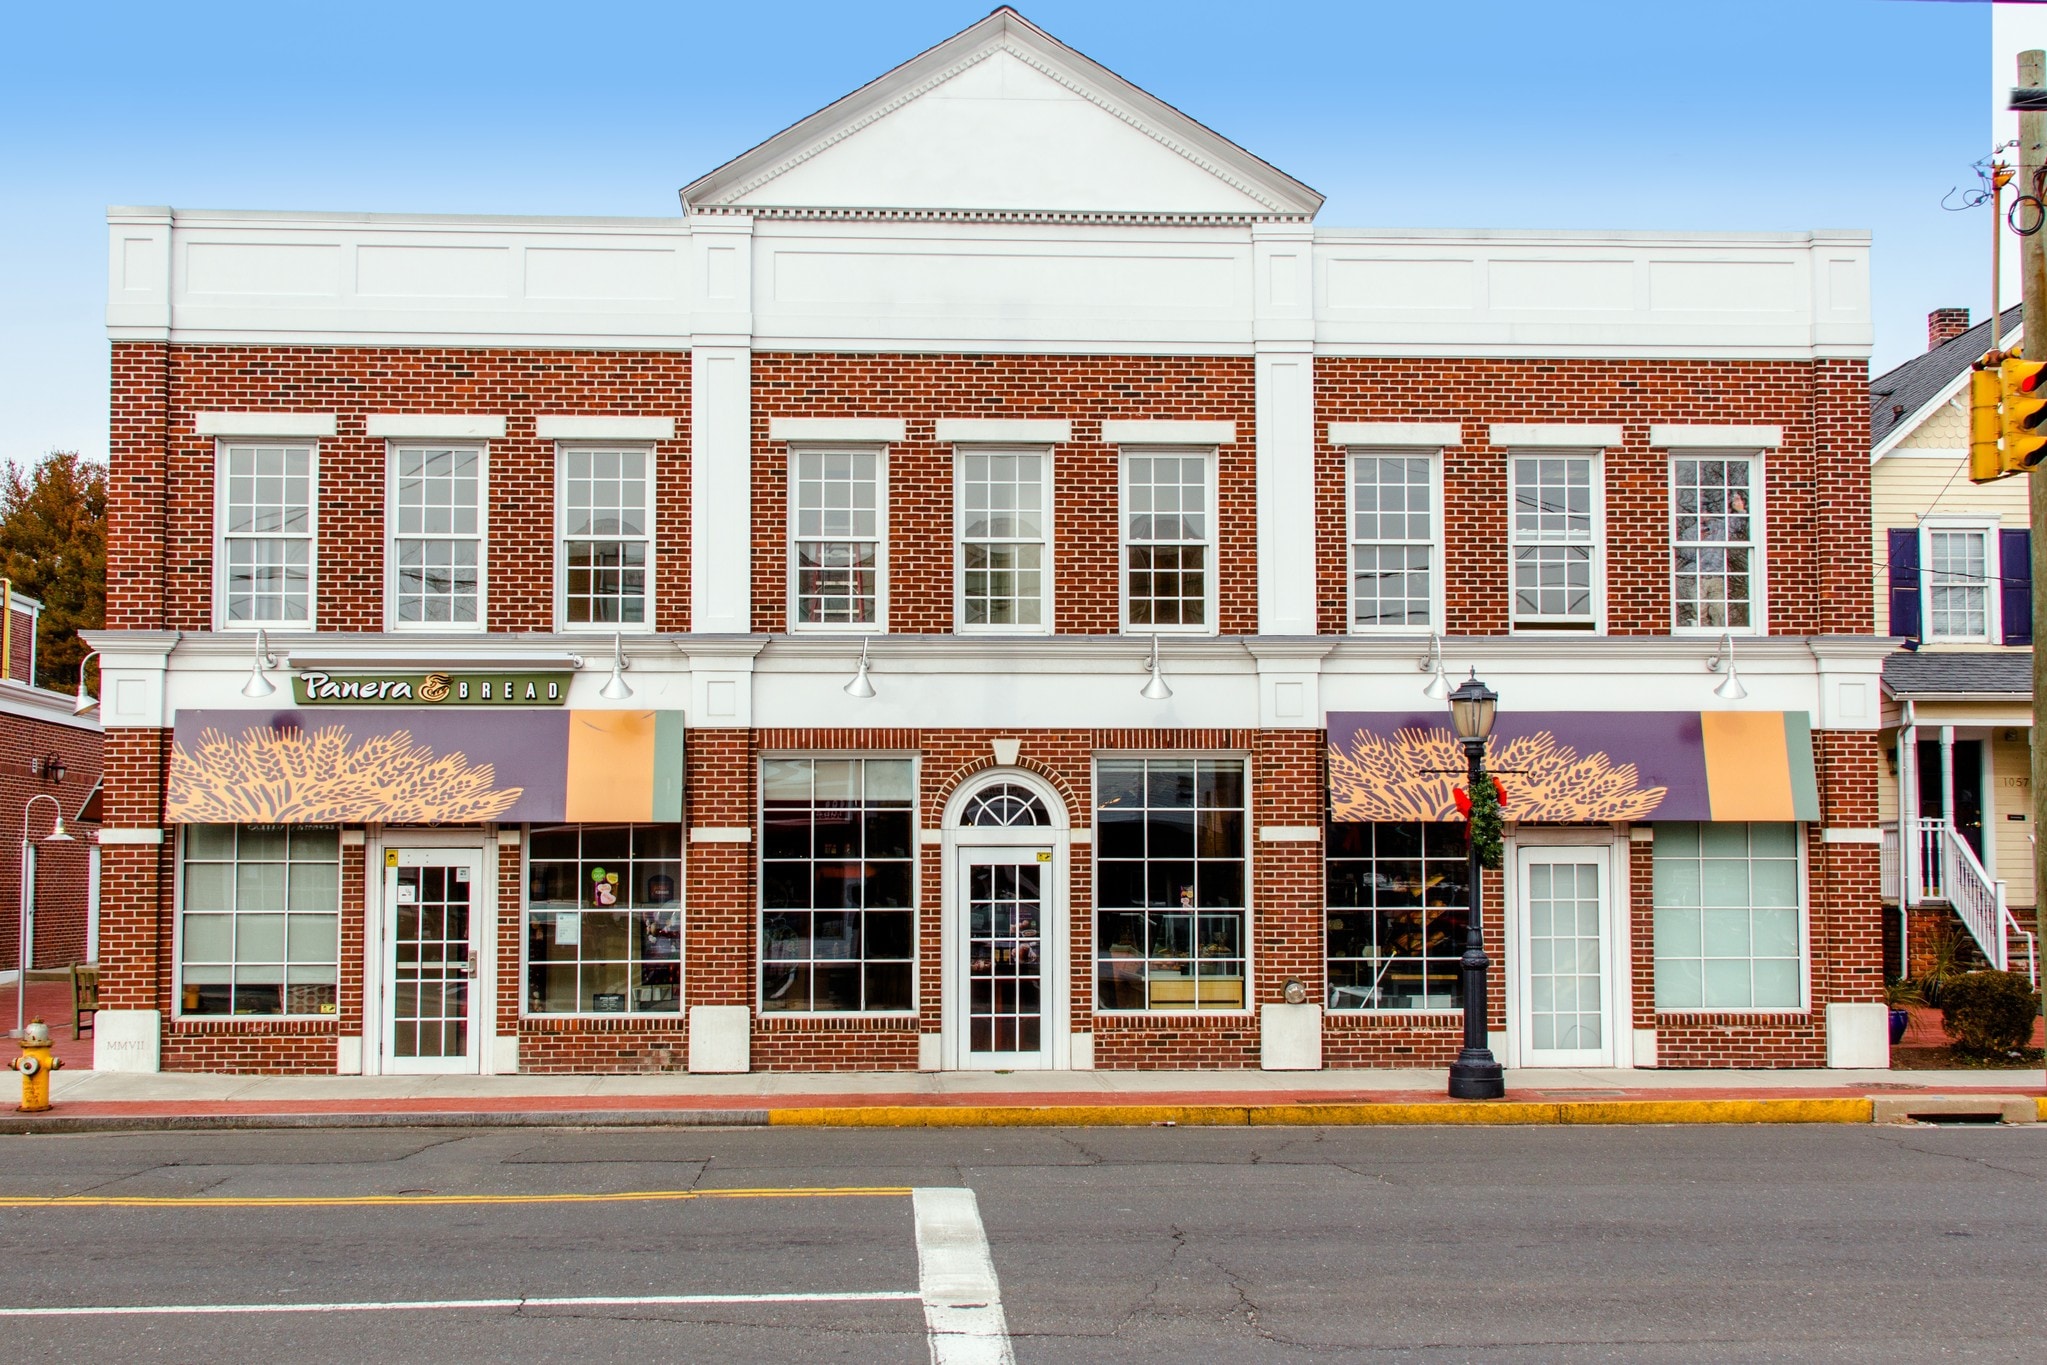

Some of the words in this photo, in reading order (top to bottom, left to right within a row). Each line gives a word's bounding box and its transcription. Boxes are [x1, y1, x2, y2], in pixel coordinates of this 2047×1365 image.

[300, 671, 412, 699] Panera
[459, 682, 558, 699] BREAD
[2004, 777, 2029, 787] 1057
[107, 1041, 145, 1050] MMVII
